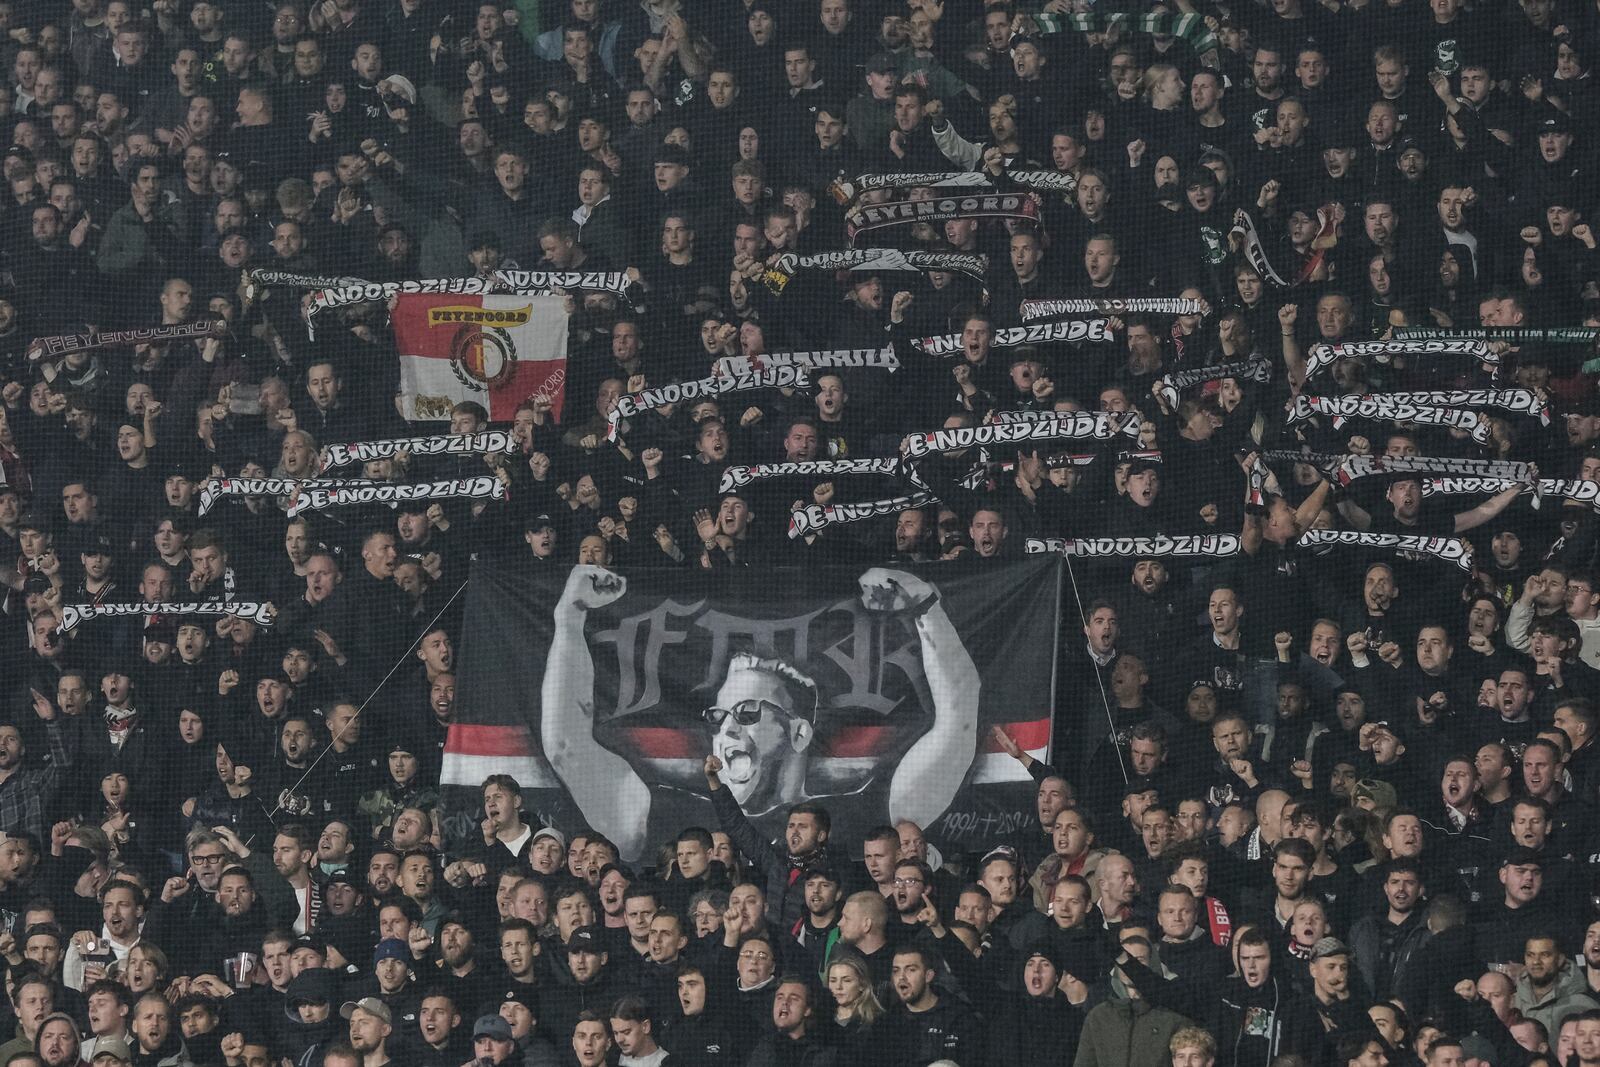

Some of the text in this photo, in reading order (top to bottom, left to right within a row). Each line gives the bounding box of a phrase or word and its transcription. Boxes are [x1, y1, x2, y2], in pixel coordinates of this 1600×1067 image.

[852, 196, 1019, 227] FEYENOORD
[917, 212, 957, 221] ROTTERDAM
[432, 311, 528, 323] FEYENOORD
[1125, 298, 1200, 314] ROTTERDA
[44, 320, 212, 354] FEYENOORD
[930, 318, 1108, 355] NRDZIJDE
[1343, 340, 1499, 364] NOORDZIJ
[758, 458, 898, 477] NOORDZIJ
[297, 489, 330, 512] DE
[792, 503, 827, 535] DE
[1075, 535, 1242, 557] NOORDZIJD
[941, 811, 979, 841] 1994
